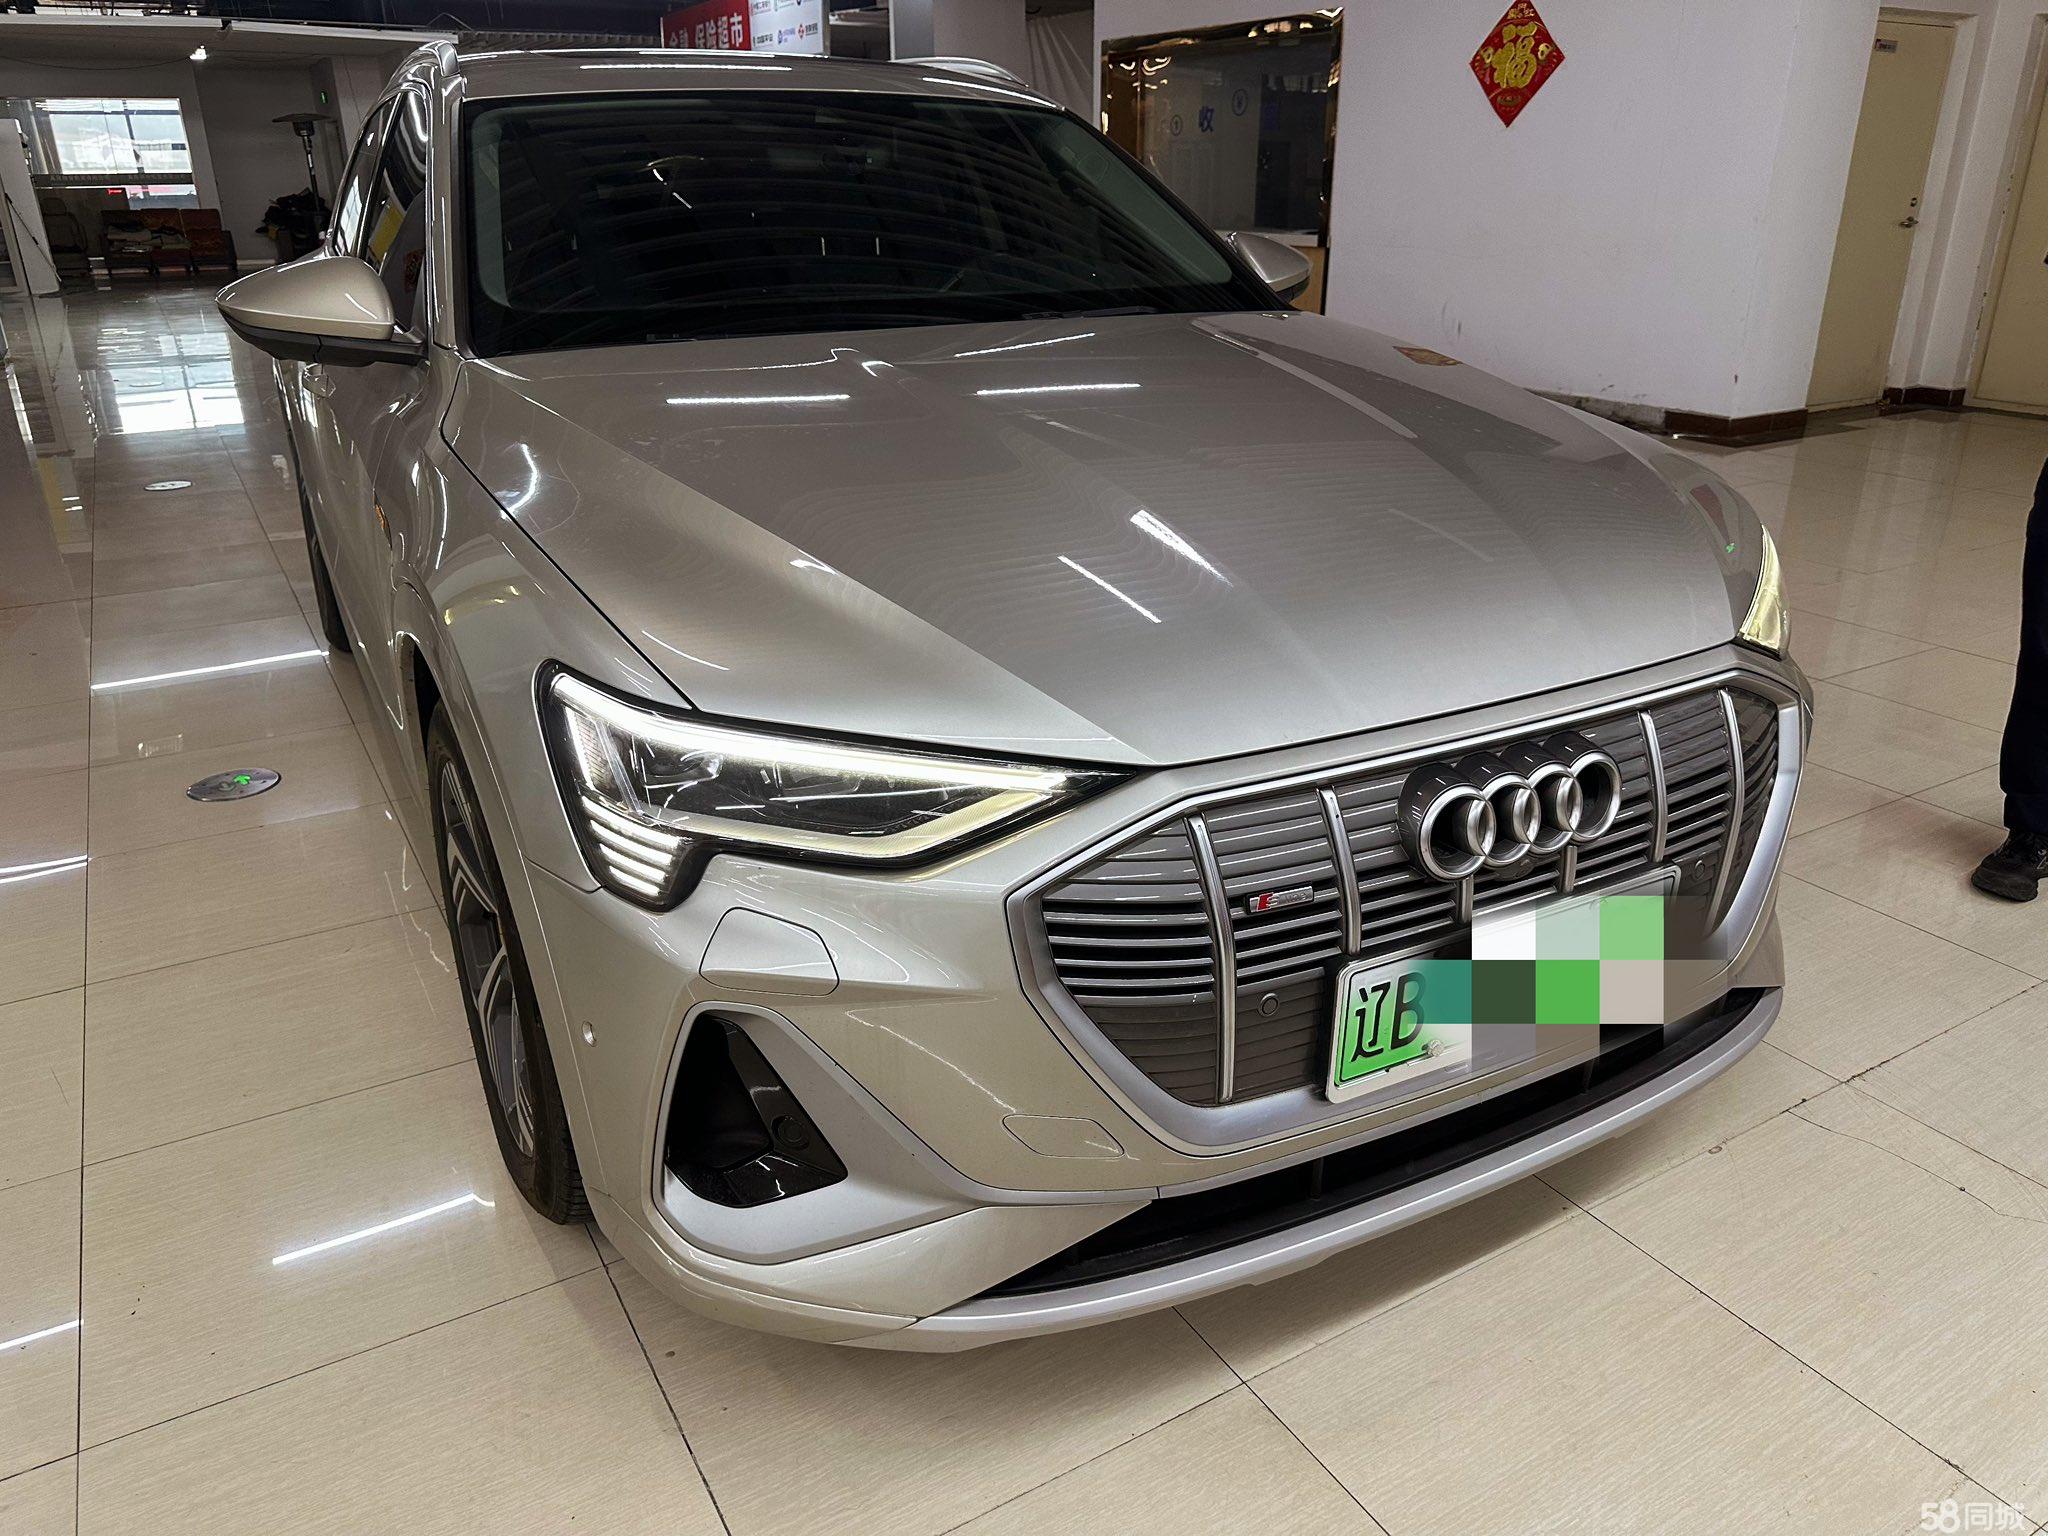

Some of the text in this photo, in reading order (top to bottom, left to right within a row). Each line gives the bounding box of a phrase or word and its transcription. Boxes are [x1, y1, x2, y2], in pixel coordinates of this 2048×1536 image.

[695, 13, 743, 48] 保险超市
[1492, 22, 1537, 88] 福
